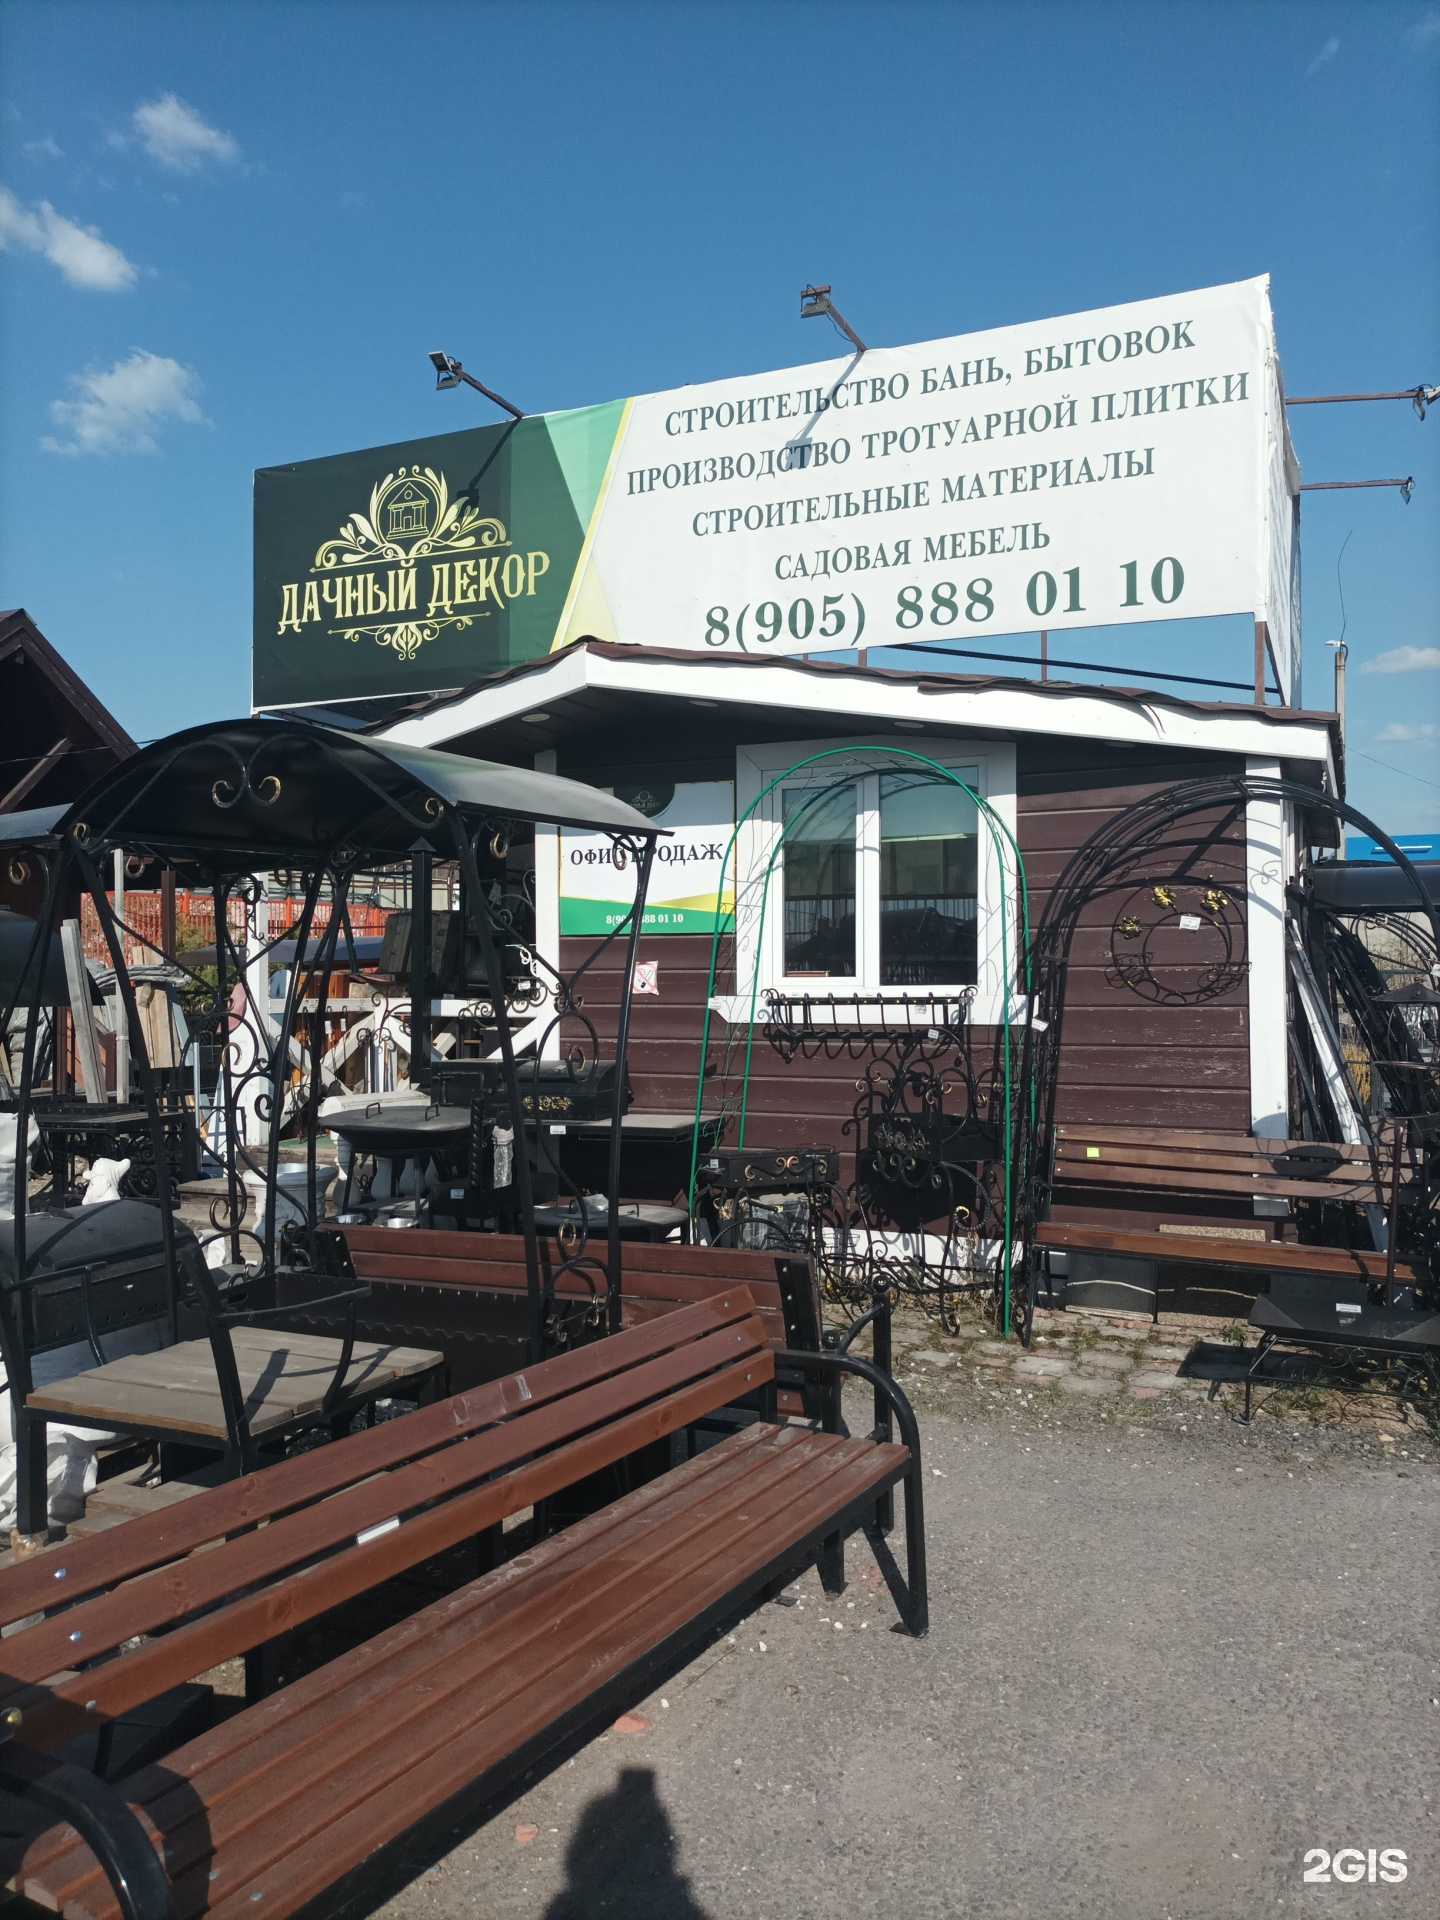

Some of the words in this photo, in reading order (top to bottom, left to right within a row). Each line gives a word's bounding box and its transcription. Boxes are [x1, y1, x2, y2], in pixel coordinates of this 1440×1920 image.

[665, 373, 910, 436] СТРОИТЕЛЬСТВО
[920, 356, 1012, 394] БАНЬ,
[1024, 320, 1195, 376] БЫТОВОК
[627, 438, 851, 496] ПРОИЗВОДСТВО
[861, 394, 1078, 459] ТРОТУАРНОЙ
[1091, 372, 1250, 423] ПЛИТКИ
[692, 480, 930, 537] СТРОИТЕЛЬНЫЕ
[941, 447, 1155, 504] МАТЕРИАЛЫ
[277, 556, 419, 636] ДАЧНЫЙ
[425, 550, 551, 619] ДЕКОР
[775, 539, 911, 582] САДОВАЯ
[923, 522, 1050, 563] МЕБЕЛЬ
[703, 592, 867, 654] 8(905)
[895, 577, 994, 630] 888
[1026, 566, 1087, 616] 01
[1119, 556, 1185, 607] 10
[630, 843, 724, 868] ПОДАЖ
[657, 913, 669, 924] 01
[672, 912, 684, 924] 10
